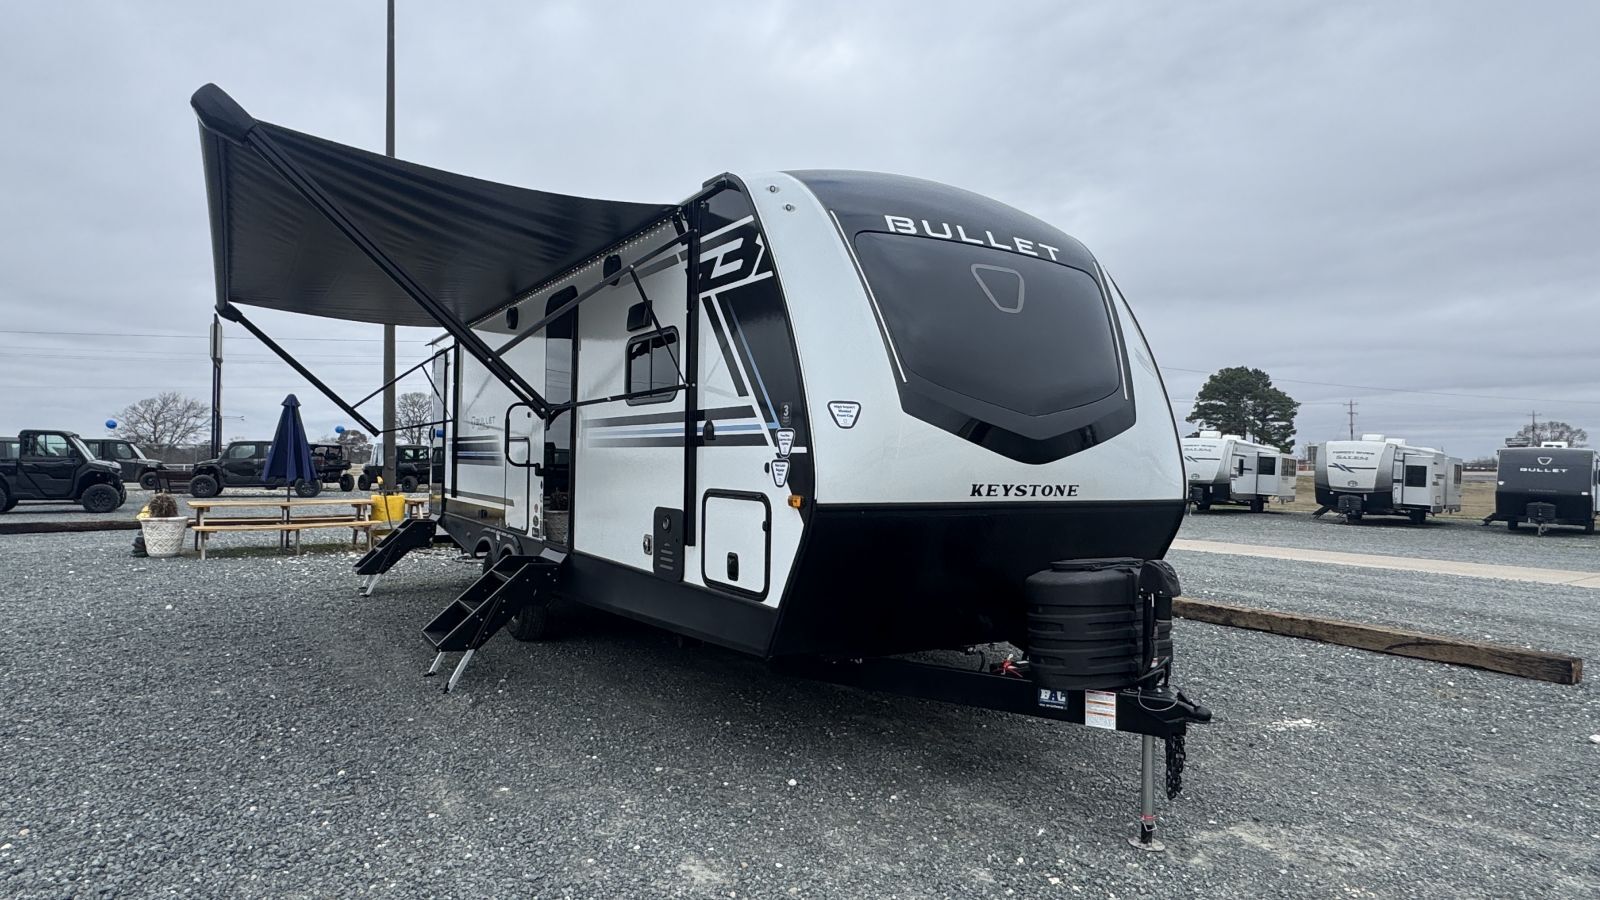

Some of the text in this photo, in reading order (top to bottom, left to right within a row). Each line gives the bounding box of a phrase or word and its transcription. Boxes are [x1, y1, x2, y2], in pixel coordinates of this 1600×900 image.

[884, 214, 1060, 262] BULLET
[784, 404, 789, 416] 3
[970, 483, 1080, 497] KEYSTONE
